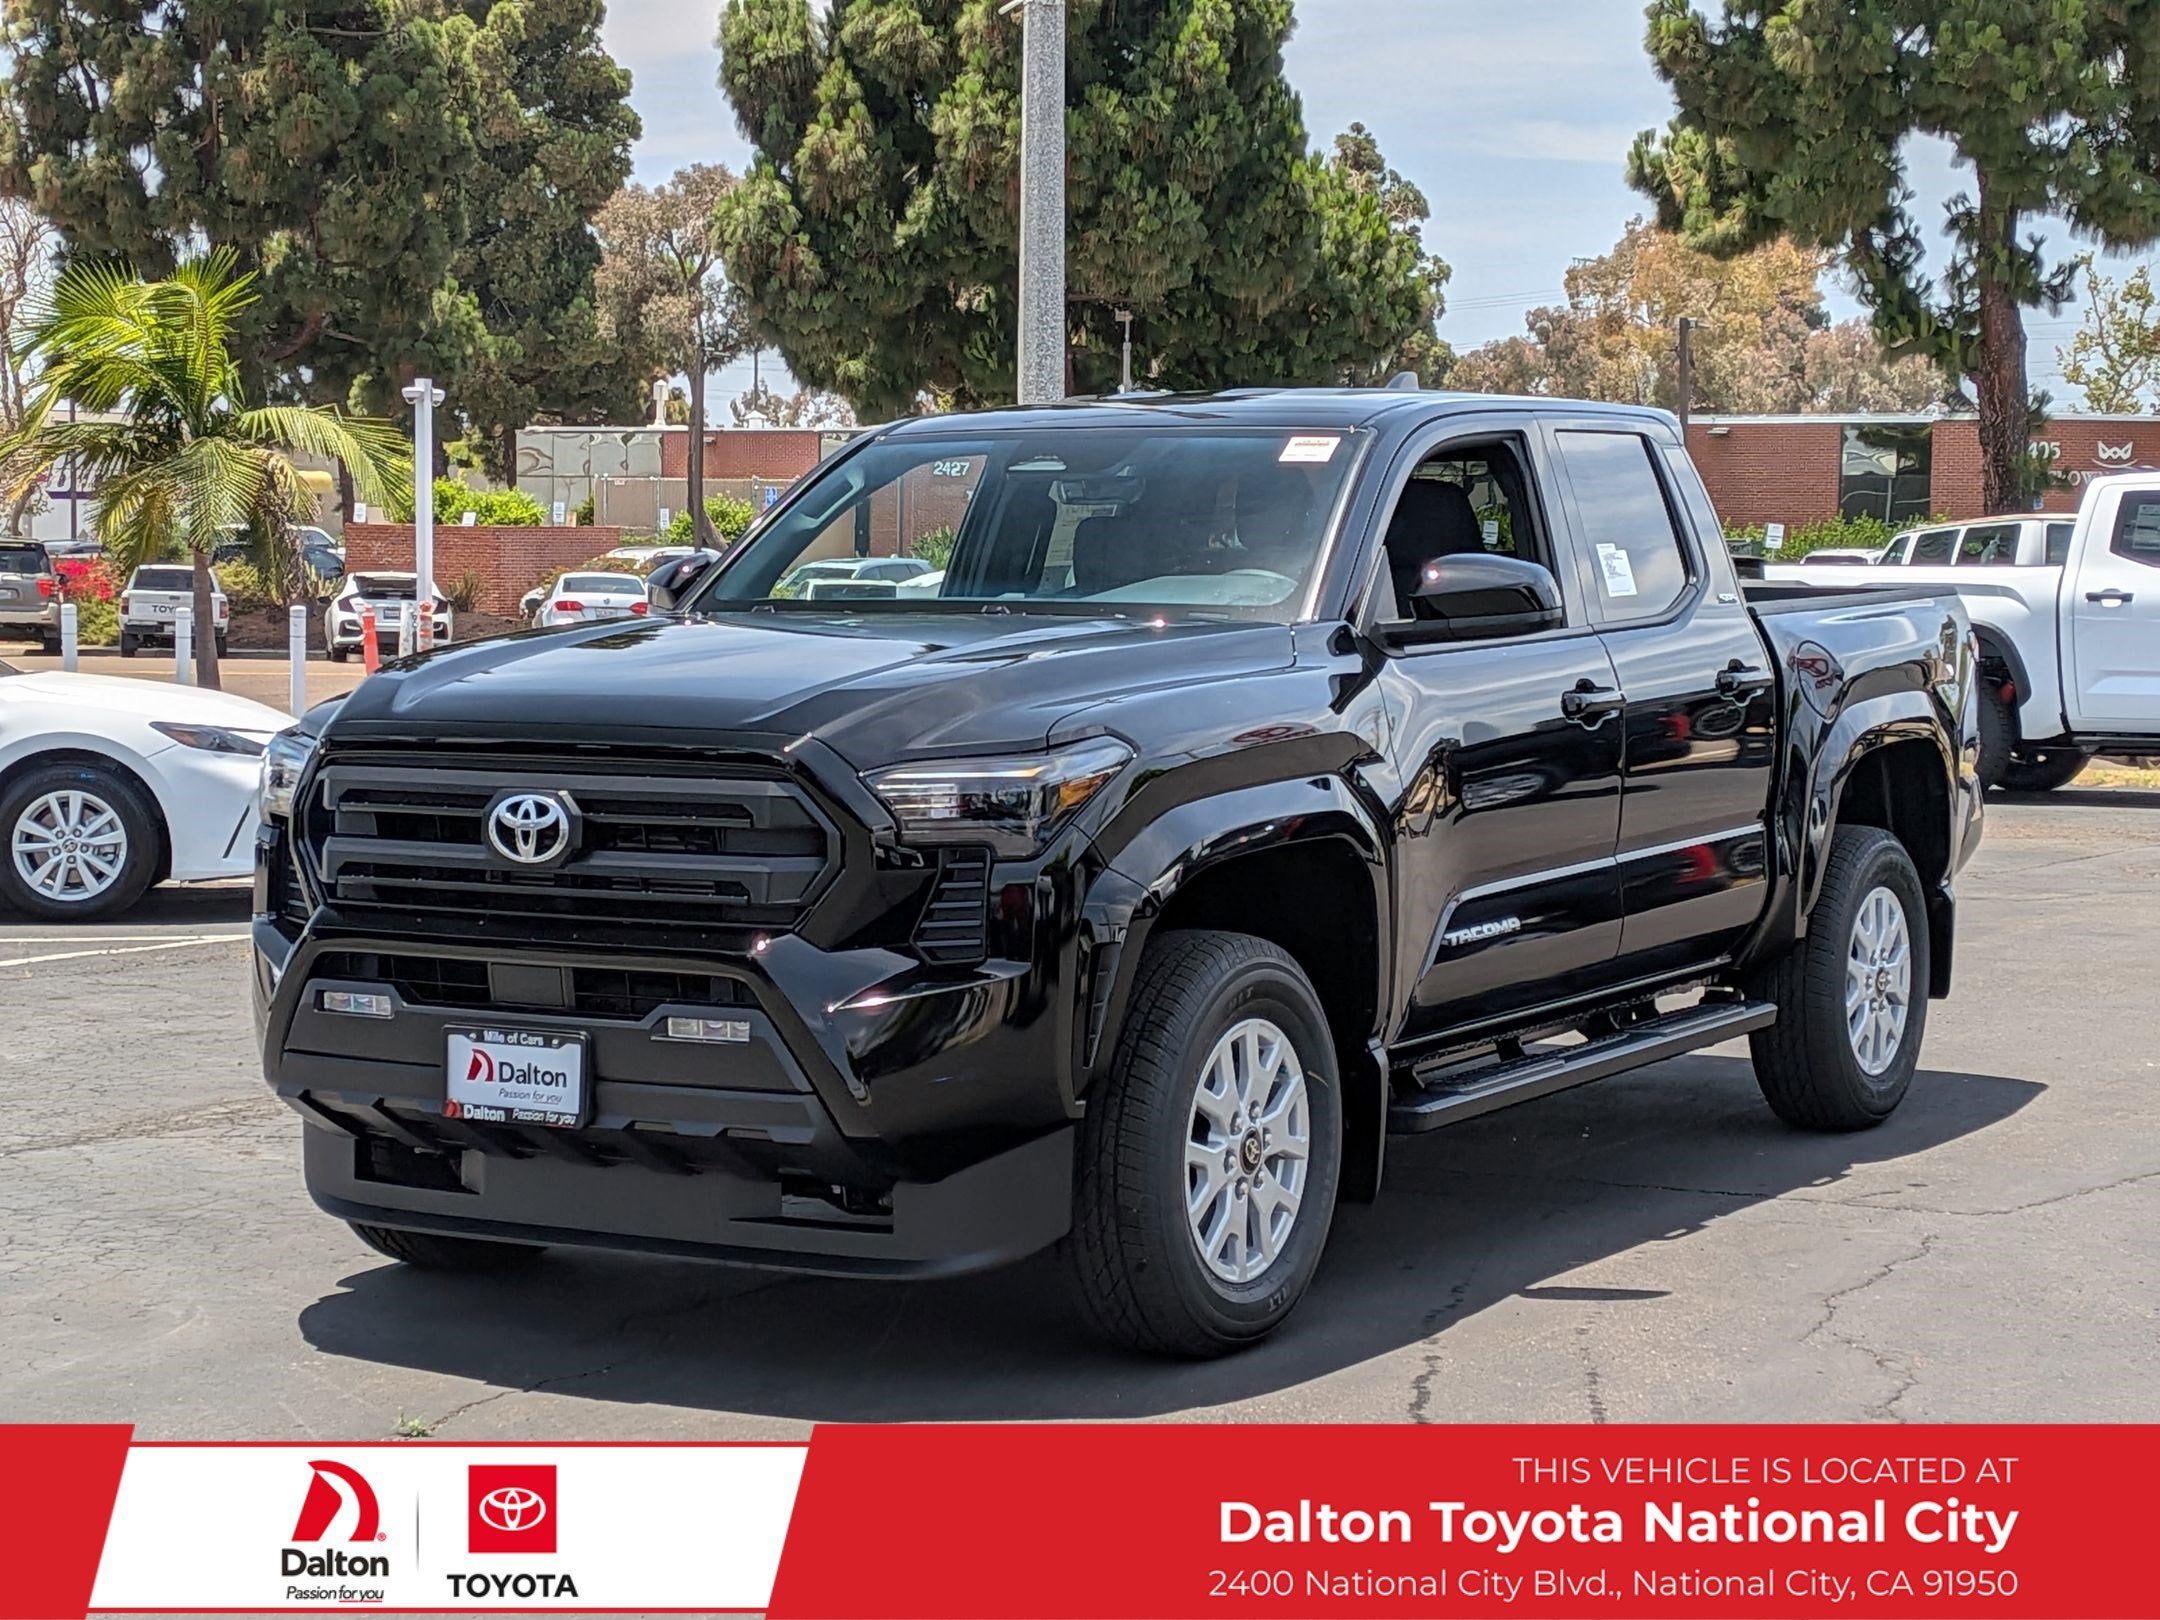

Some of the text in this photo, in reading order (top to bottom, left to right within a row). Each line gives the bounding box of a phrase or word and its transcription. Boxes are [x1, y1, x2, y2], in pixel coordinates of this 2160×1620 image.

[933, 461, 970, 477] 2427
[1444, 916, 1521, 946] TACOMA
[483, 1030, 544, 1046] Mile of Cars
[498, 1061, 567, 1088] Dalton
[498, 1087, 563, 1105] Passion for you
[463, 1104, 577, 1125] Dalton Passion for you
